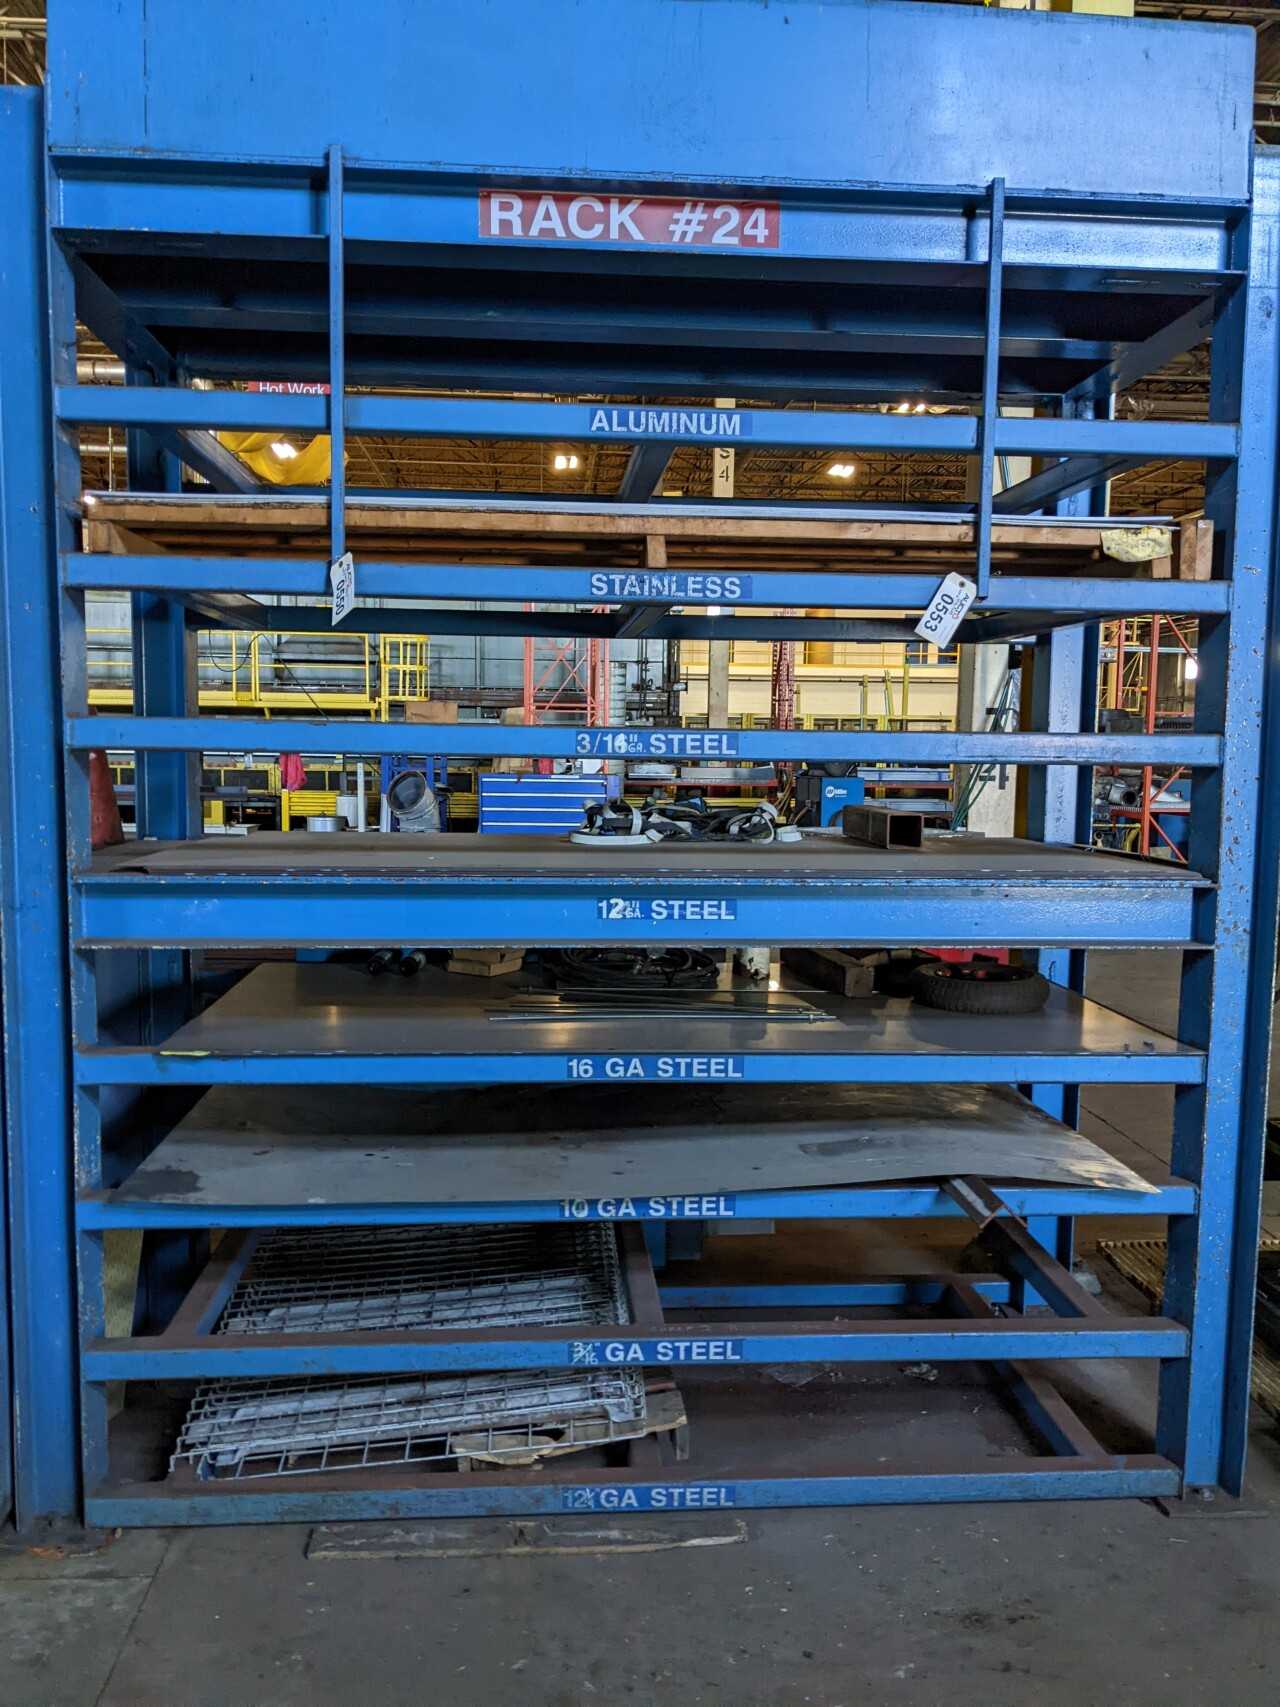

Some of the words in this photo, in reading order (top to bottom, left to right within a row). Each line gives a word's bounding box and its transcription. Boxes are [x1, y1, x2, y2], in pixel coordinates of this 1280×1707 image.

[490, 192, 645, 241] RACK
[668, 201, 769, 245] #24
[259, 381, 283, 393] Hot
[287, 382, 325, 394] Work
[591, 409, 741, 436] ALUMINUM
[591, 573, 742, 599] STAINLESS
[335, 579, 345, 616] 0550
[924, 593, 954, 632] 0553
[650, 733, 737, 755] STEEL
[651, 899, 735, 920] STEEL
[568, 1058, 594, 1078] 16
[605, 1057, 645, 1078] GA
[657, 1057, 742, 1078] STEEL
[560, 1198, 588, 1218] 10
[597, 1198, 637, 1217] GA
[650, 1196, 733, 1217] STEEL
[605, 1342, 645, 1362] GA
[657, 1341, 741, 1361] STEEL
[600, 1488, 638, 1508] GA
[651, 1487, 733, 1507] STEEL
